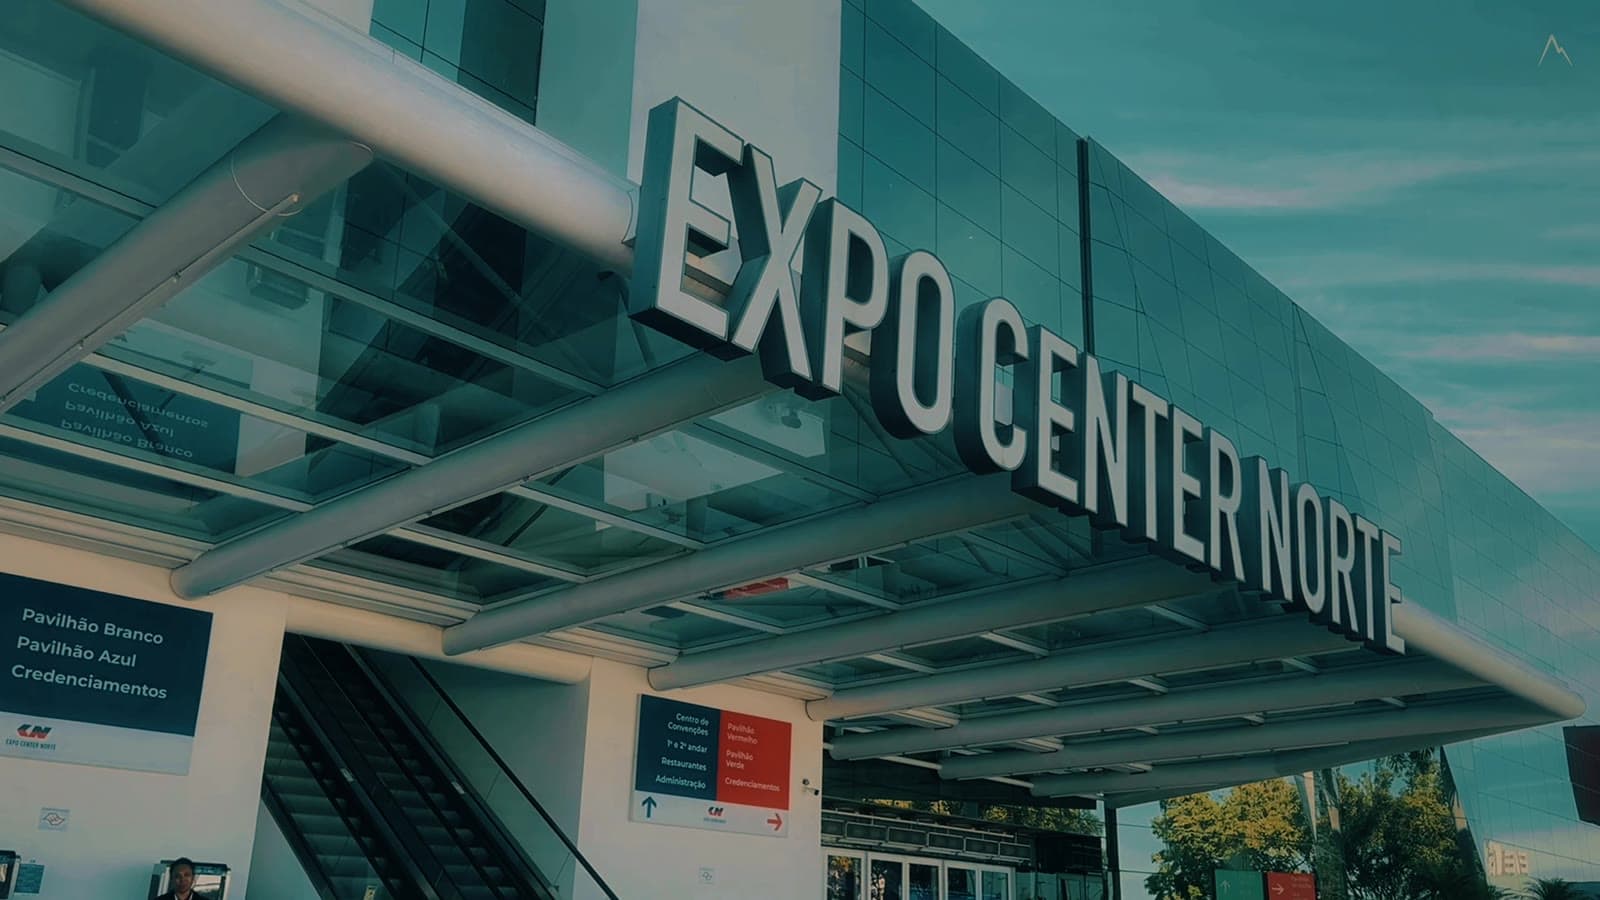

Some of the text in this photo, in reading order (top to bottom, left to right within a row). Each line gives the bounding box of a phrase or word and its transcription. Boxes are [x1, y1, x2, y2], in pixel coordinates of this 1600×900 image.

[644, 96, 1406, 656] EXPO CENTER NORTE
[22, 607, 164, 645] Pavilhão Branco
[16, 635, 137, 667] Pavilhão Azul
[11, 664, 168, 699] Credenciamentos
[676, 712, 709, 726] Centro de
[667, 721, 709, 736] Convenções
[727, 722, 755, 735] Pavilhão
[727, 732, 758, 745] Vermelho
[687, 743, 708, 753] andar
[726, 749, 754, 761] Pavilhão
[661, 756, 707, 771] Restaurantes
[725, 759, 745, 770] Verde
[655, 774, 706, 790] Administração
[724, 776, 781, 792] Credenciamentos
